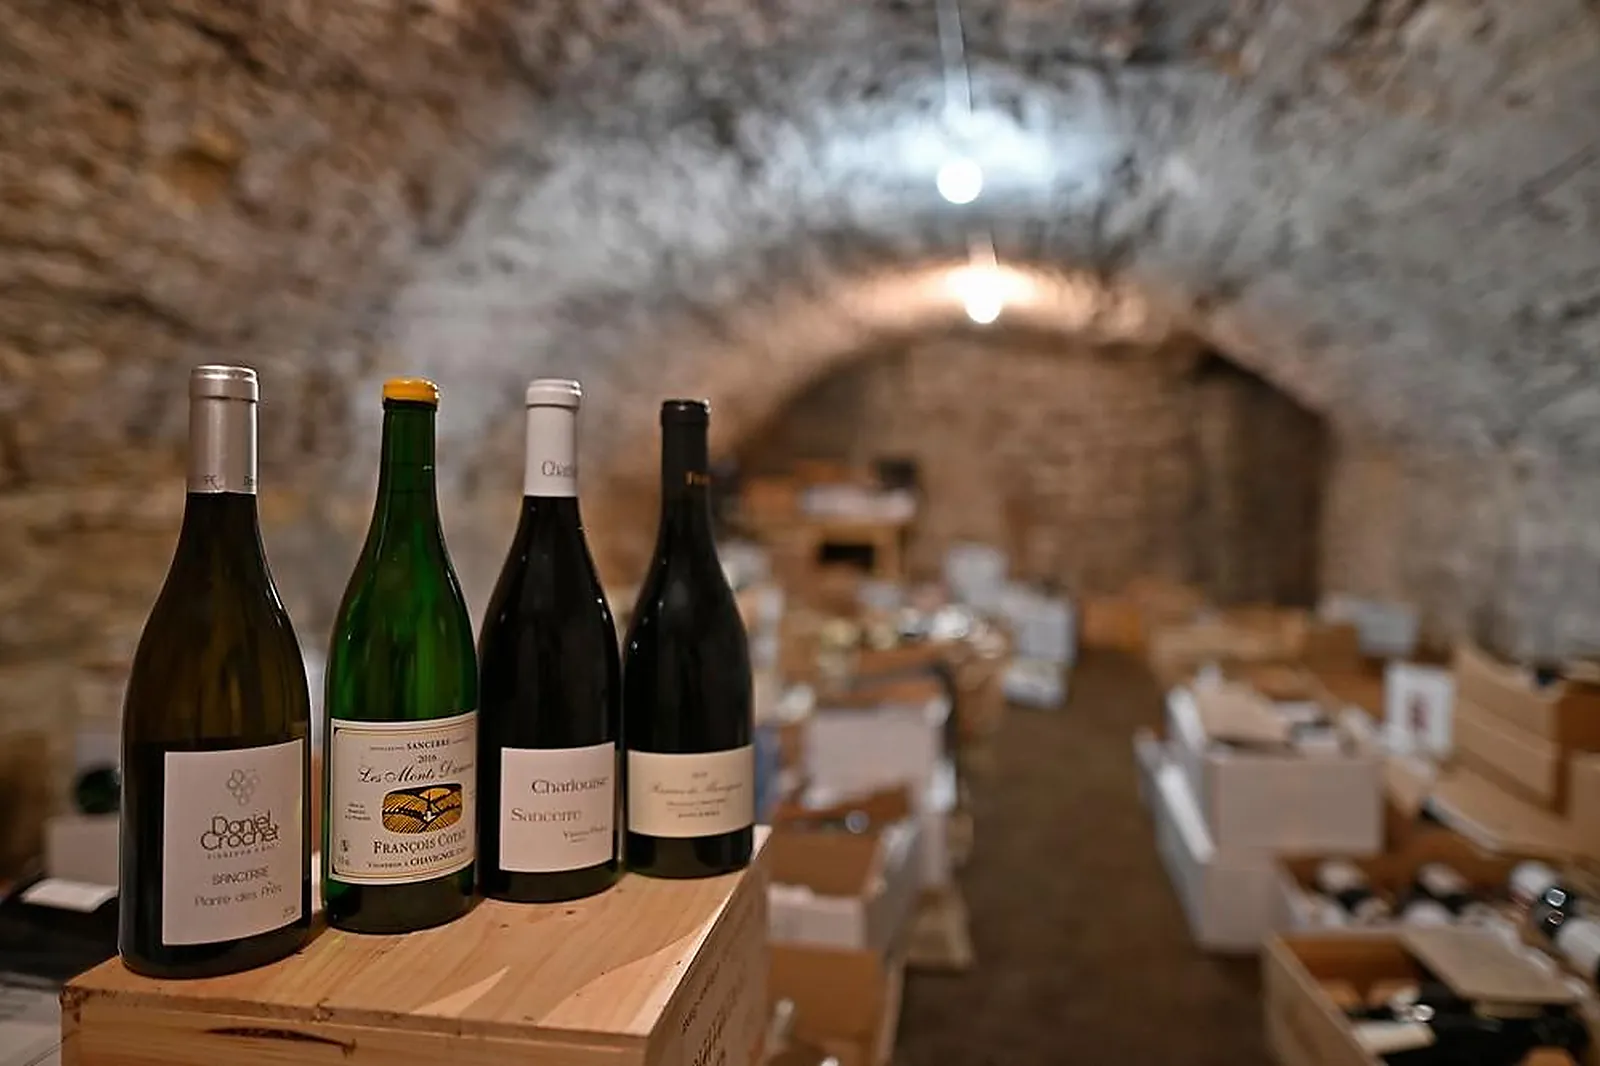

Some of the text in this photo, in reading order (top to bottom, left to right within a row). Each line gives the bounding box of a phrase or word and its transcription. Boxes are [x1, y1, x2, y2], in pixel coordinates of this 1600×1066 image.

[357, 765, 382, 784] Les
[530, 776, 609, 795] Charlouise
[211, 809, 271, 836] Daniel
[510, 807, 582, 822] Sancerre
[200, 823, 280, 851] Crochet
[373, 839, 436, 855] FRANÇOIS
